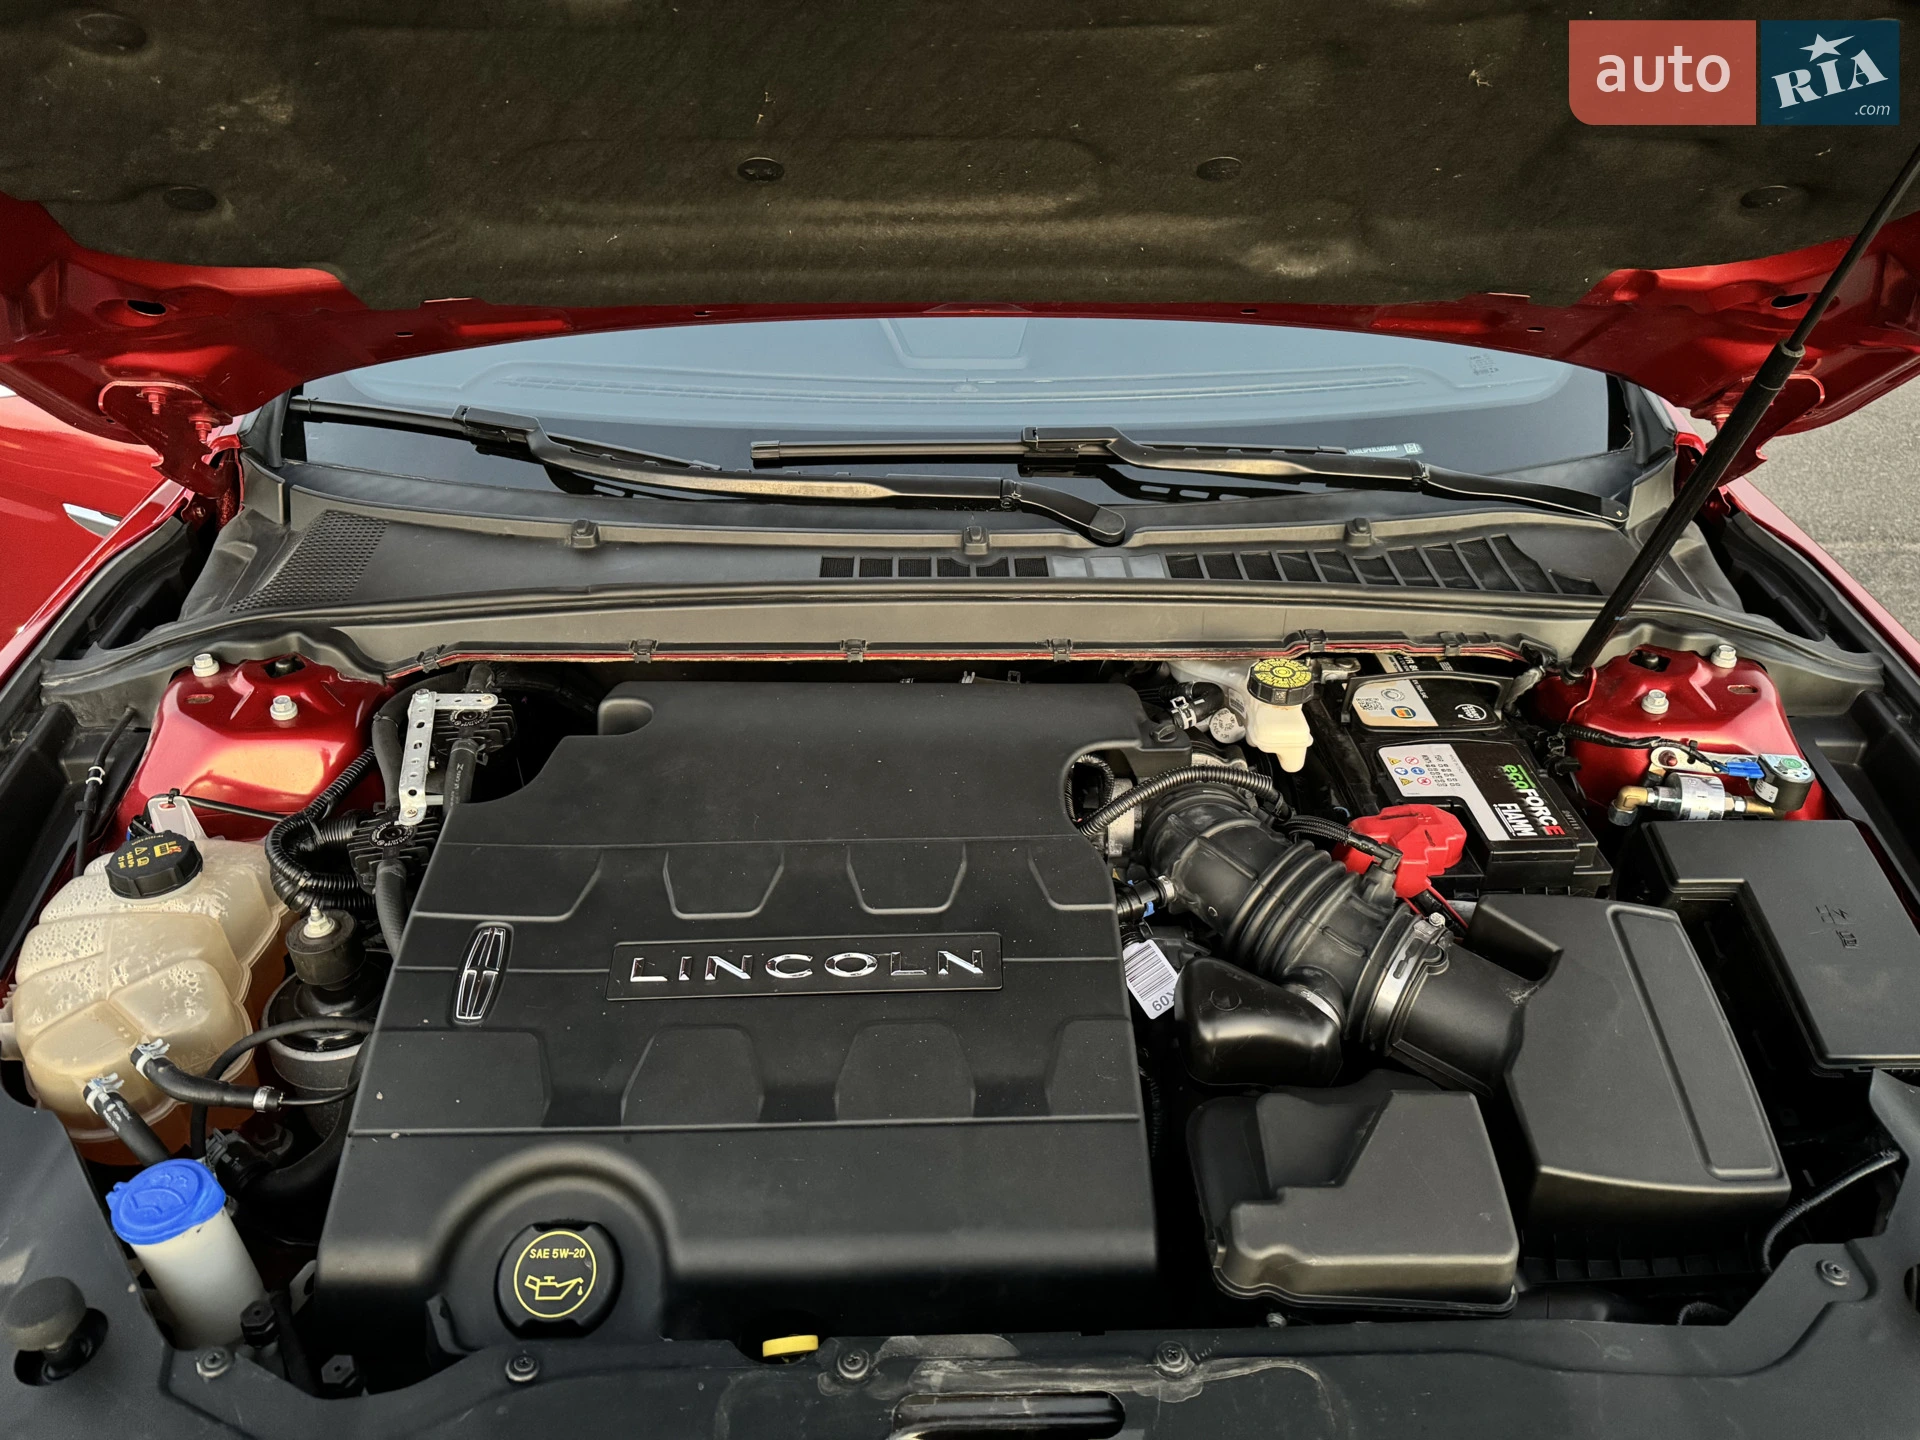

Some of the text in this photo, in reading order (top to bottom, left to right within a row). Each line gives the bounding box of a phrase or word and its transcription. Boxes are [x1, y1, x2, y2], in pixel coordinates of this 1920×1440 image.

[1504, 765, 1566, 836] ecoFORCE
[1498, 804, 1538, 836] FIAMM
[629, 950, 984, 983] LINCOLN
[529, 1248, 586, 1259] SAE 5W-20
